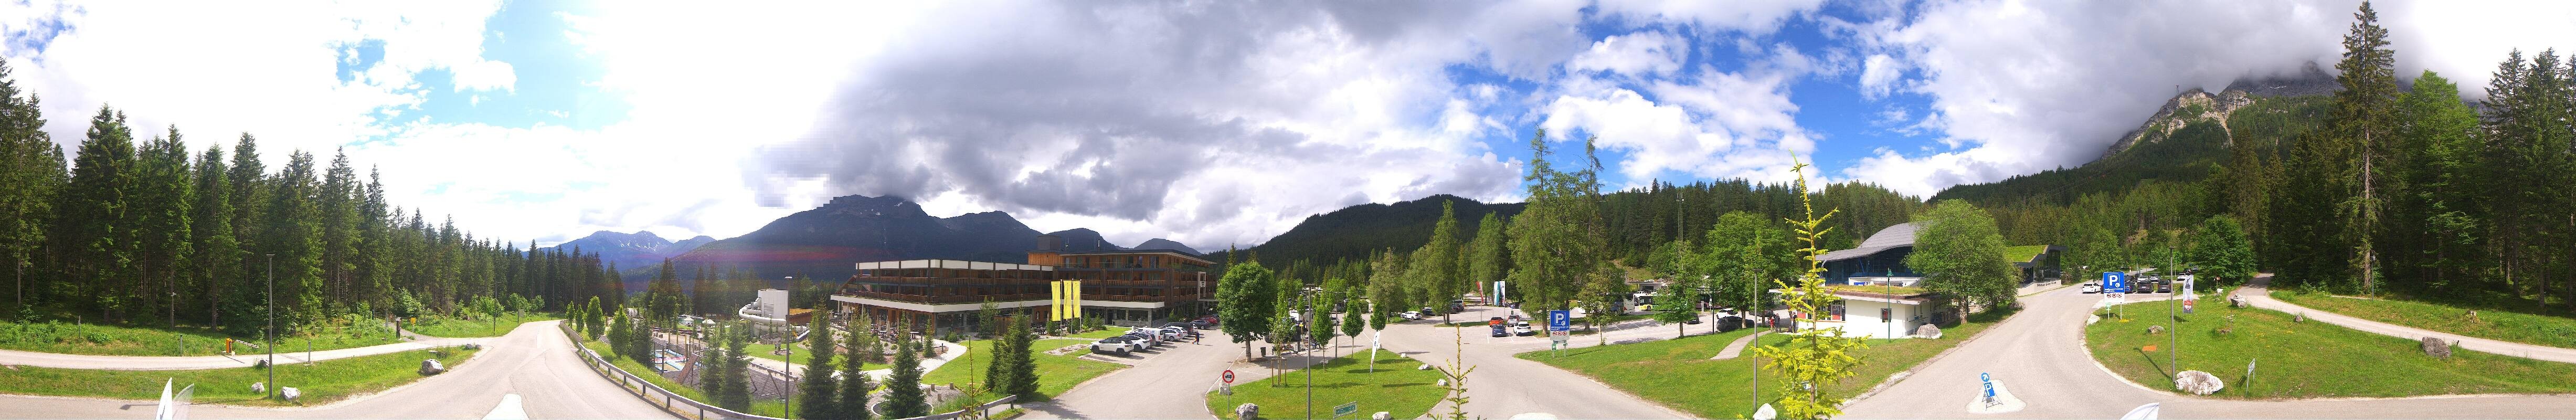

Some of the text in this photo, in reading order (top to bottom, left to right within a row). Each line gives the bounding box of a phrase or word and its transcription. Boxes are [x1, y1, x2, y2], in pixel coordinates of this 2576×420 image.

[2109, 275, 2118, 286] P
[1555, 313, 1564, 324] P
[1985, 383, 1992, 396] P
